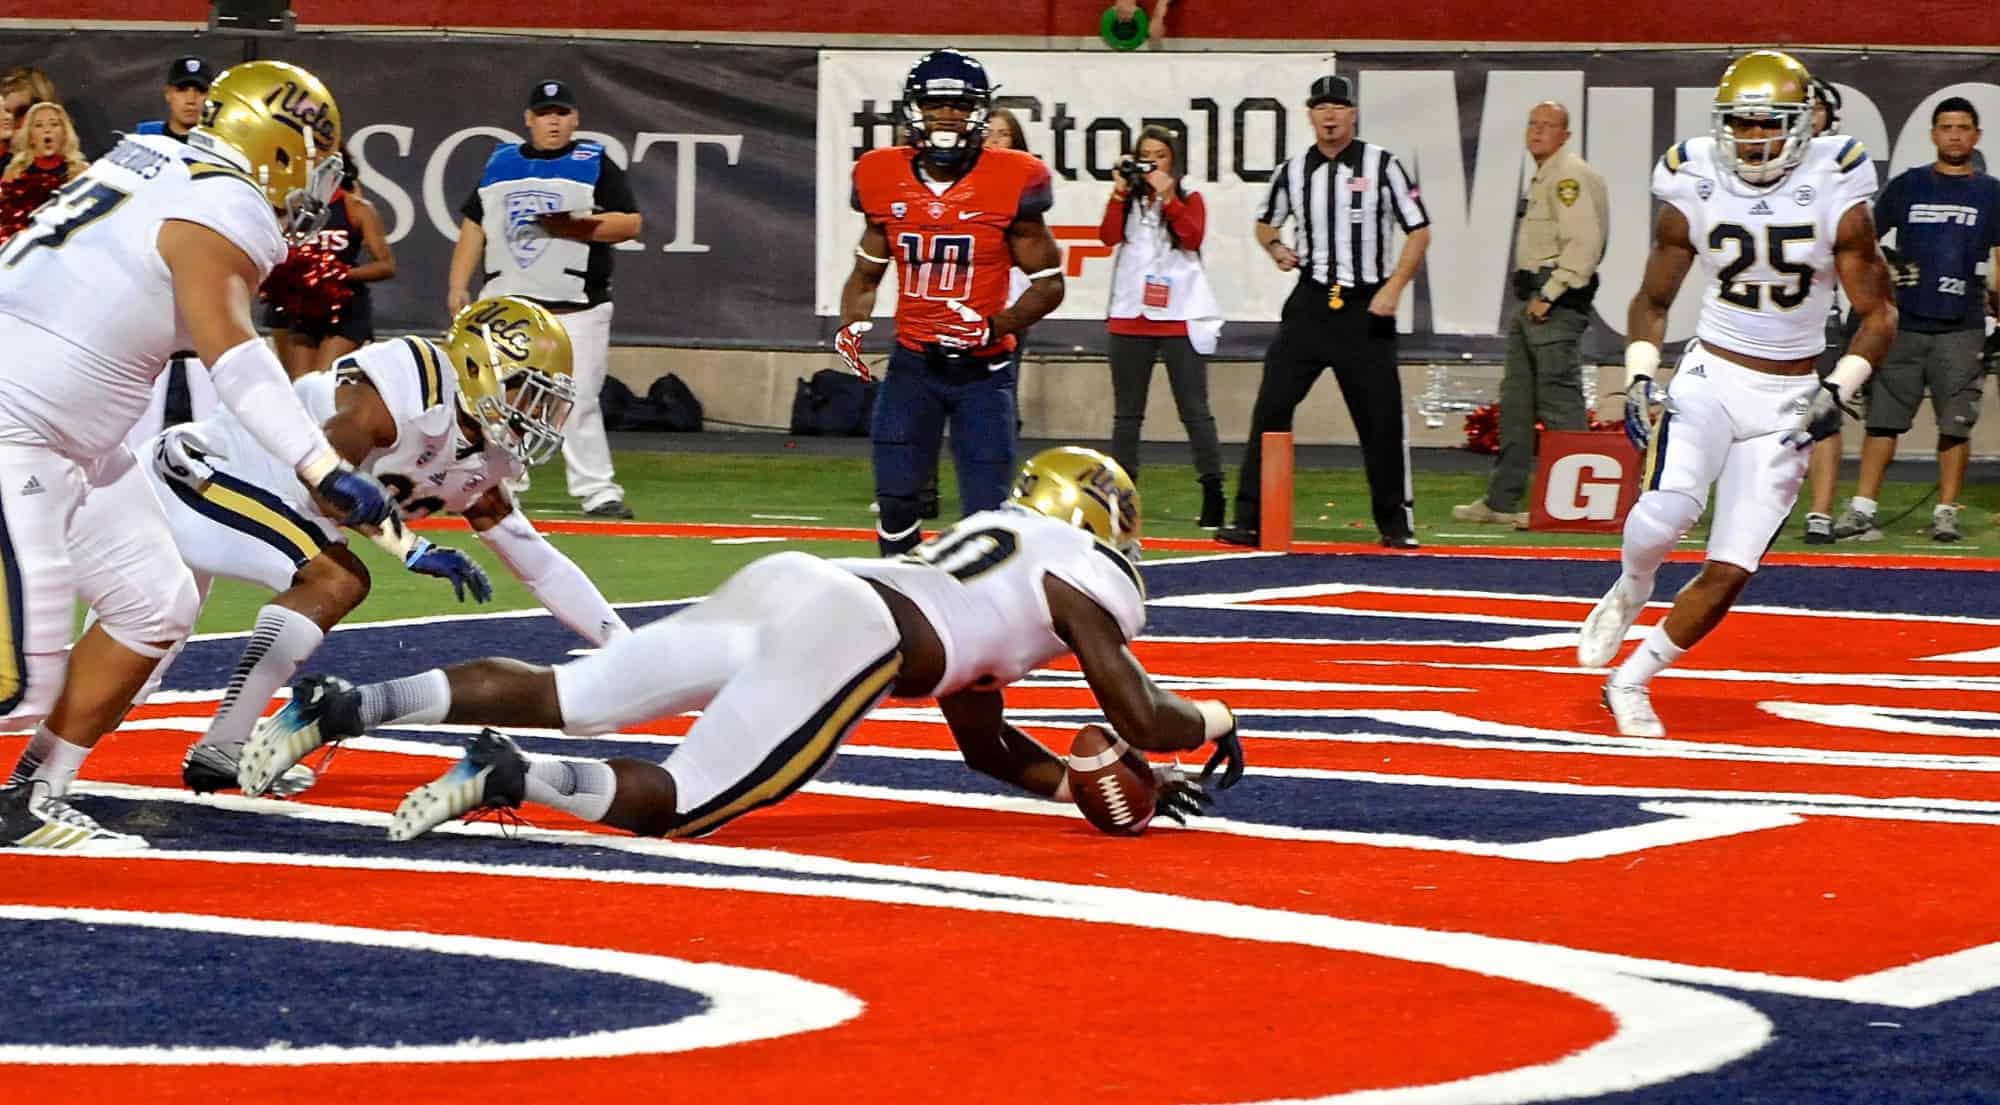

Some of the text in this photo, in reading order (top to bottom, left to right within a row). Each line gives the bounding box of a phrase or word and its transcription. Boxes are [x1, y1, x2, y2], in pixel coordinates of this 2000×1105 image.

[1908, 204, 1979, 227] ESPN
[897, 232, 975, 301] 10
[1707, 221, 1816, 312] 25
[1544, 453, 1623, 520] G
